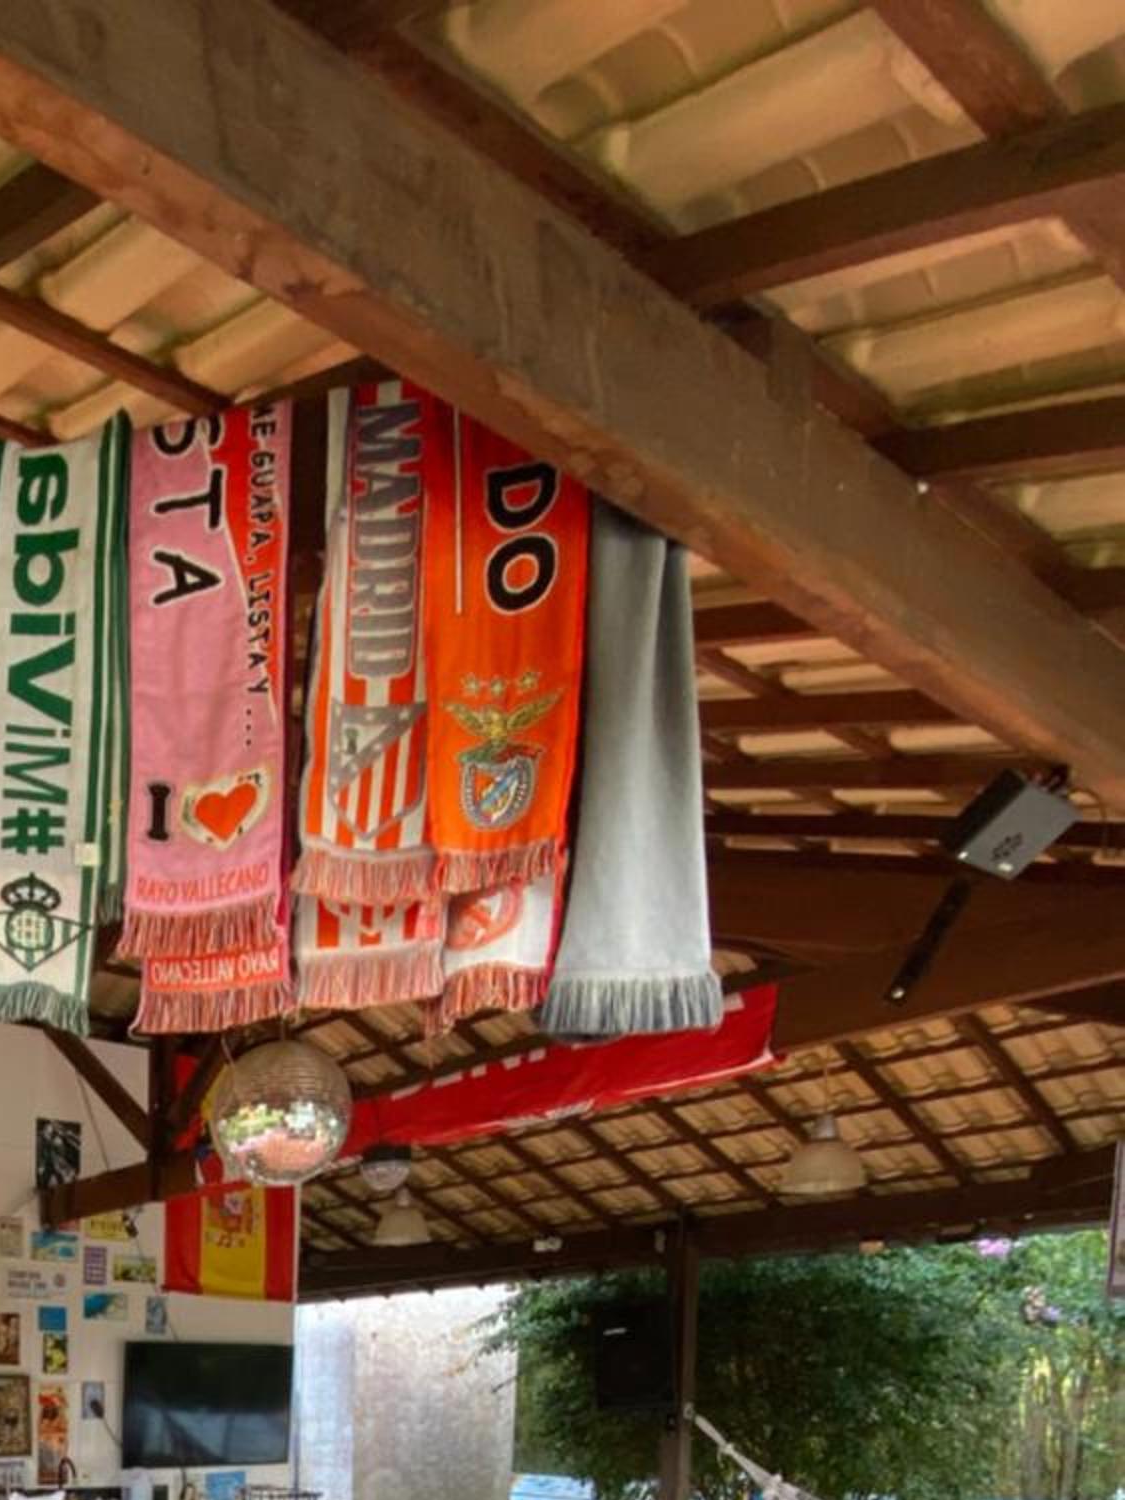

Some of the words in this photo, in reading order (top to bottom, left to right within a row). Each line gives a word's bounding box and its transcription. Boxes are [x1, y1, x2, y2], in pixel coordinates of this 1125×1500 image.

[350, 402, 423, 677] MADRID
[487, 463, 558, 612] DO
[148, 783, 171, 841] I
[136, 877, 178, 903] RAYO
[179, 863, 269, 902] VALLECANO
